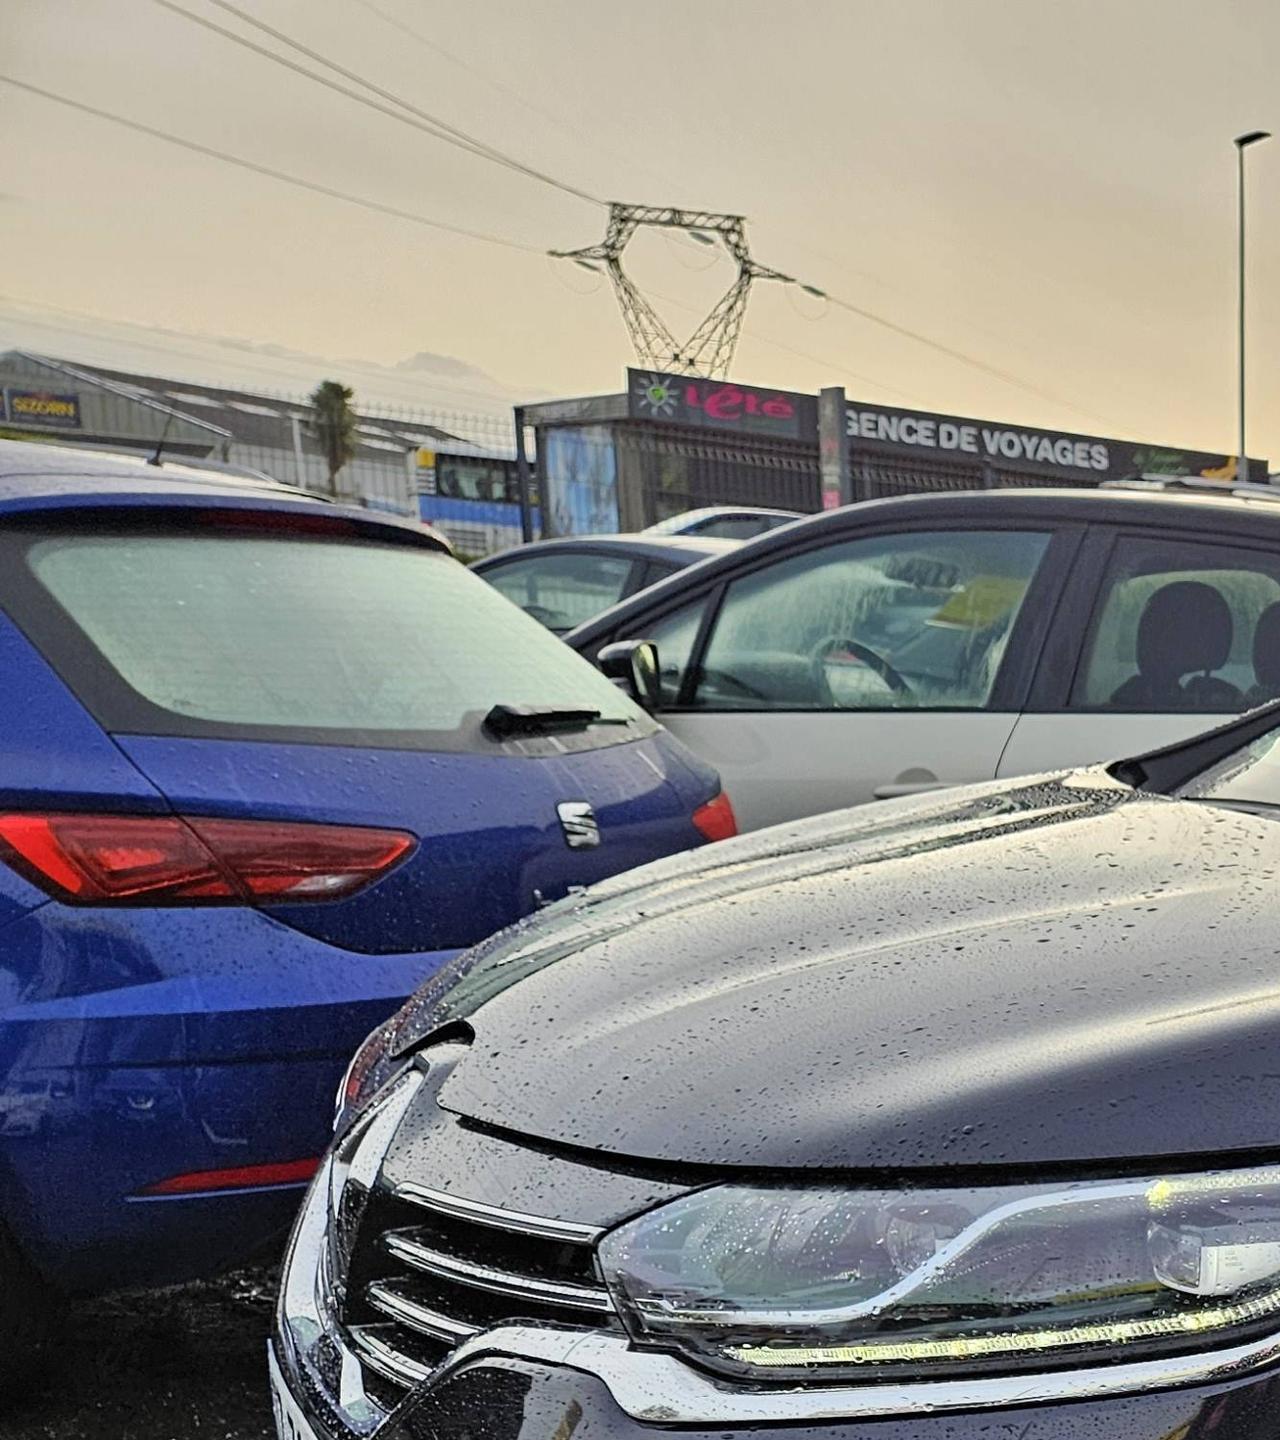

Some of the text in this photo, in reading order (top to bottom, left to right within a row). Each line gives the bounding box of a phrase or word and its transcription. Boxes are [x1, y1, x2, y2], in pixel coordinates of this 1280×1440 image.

[846, 409, 936, 447] GENCE
[938, 423, 978, 453] DE
[981, 430, 1109, 471] VOYAGES
